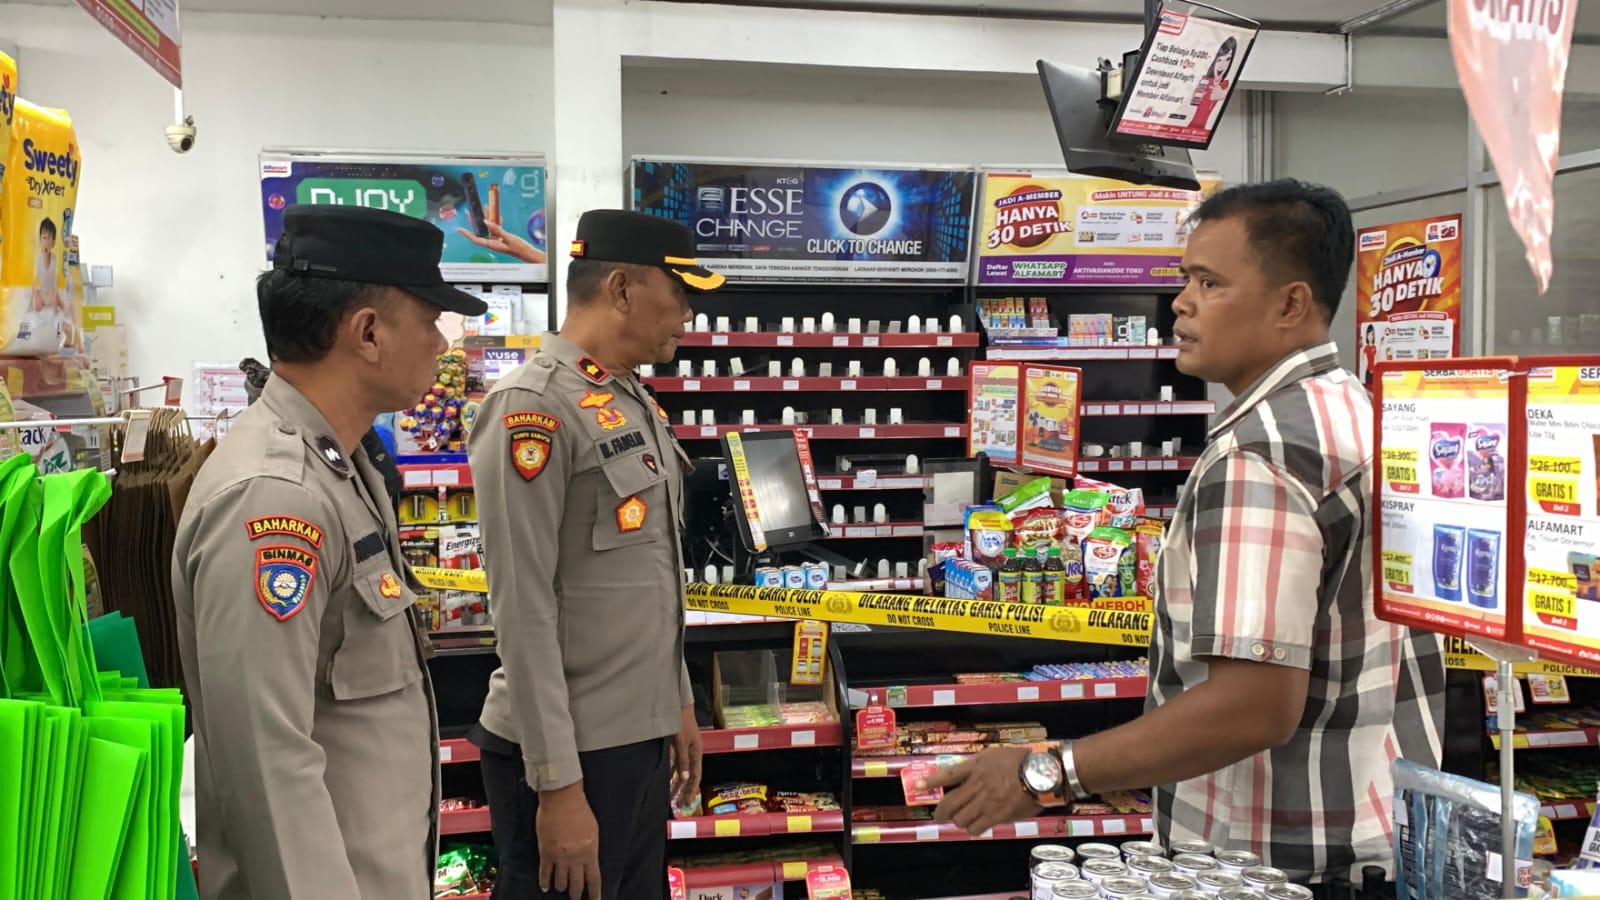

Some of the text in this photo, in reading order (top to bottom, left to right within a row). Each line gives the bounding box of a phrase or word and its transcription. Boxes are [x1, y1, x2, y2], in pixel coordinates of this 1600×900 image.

[1151, 54, 1179, 66] Cashback
[23, 138, 78, 187] Sweety
[776, 177, 799, 185] KT&G
[729, 188, 804, 216] ESSE
[998, 191, 1060, 206] JADI A-MEMBER
[1117, 191, 1147, 199] UNTUNG
[996, 205, 1059, 227] HANYA
[695, 218, 803, 238] CHANGE
[987, 221, 1073, 249] 30 DETIK
[806, 239, 922, 255] CLICK TO CHANGE
[986, 263, 1009, 271] Daftar
[986, 269, 1008, 277] Lewat
[1012, 261, 1067, 270] WHATSAPP
[1012, 269, 1066, 279] ALFAMART
[1373, 259, 1424, 291] HANYA
[1369, 276, 1446, 318] 30 DETIK
[1382, 403, 1416, 413] SAYANG
[1527, 409, 1554, 420] DEKA
[507, 414, 556, 429] BAHARKAM
[1387, 466, 1417, 482] GRATIS 1
[1536, 482, 1573, 500] GRATIS 1
[1382, 500, 1415, 512] KISPRAY
[252, 518, 320, 543] BAHARKAM
[1527, 519, 1584, 537] ALFAMART
[262, 549, 313, 567] BINMAS
[710, 583, 757, 600] MELINTAS
[758, 587, 788, 601] GARIS
[789, 589, 824, 606] POLISI
[688, 598, 730, 611] DO NOT CROSS
[774, 604, 812, 617] POLICE LINE
[858, 593, 910, 611] DILARANG
[912, 597, 967, 617] MELINTAS
[969, 601, 1003, 621] GARIS
[1006, 604, 1046, 623] POLISI
[1535, 594, 1572, 614] GRATIS 1
[887, 613, 935, 627] DO NOT CROSS
[1087, 609, 1150, 632] DILARANG
[987, 621, 1032, 635] POLICE LINE
[1121, 633, 1150, 645] DO NOT
[1543, 663, 1577, 674] POLICE
